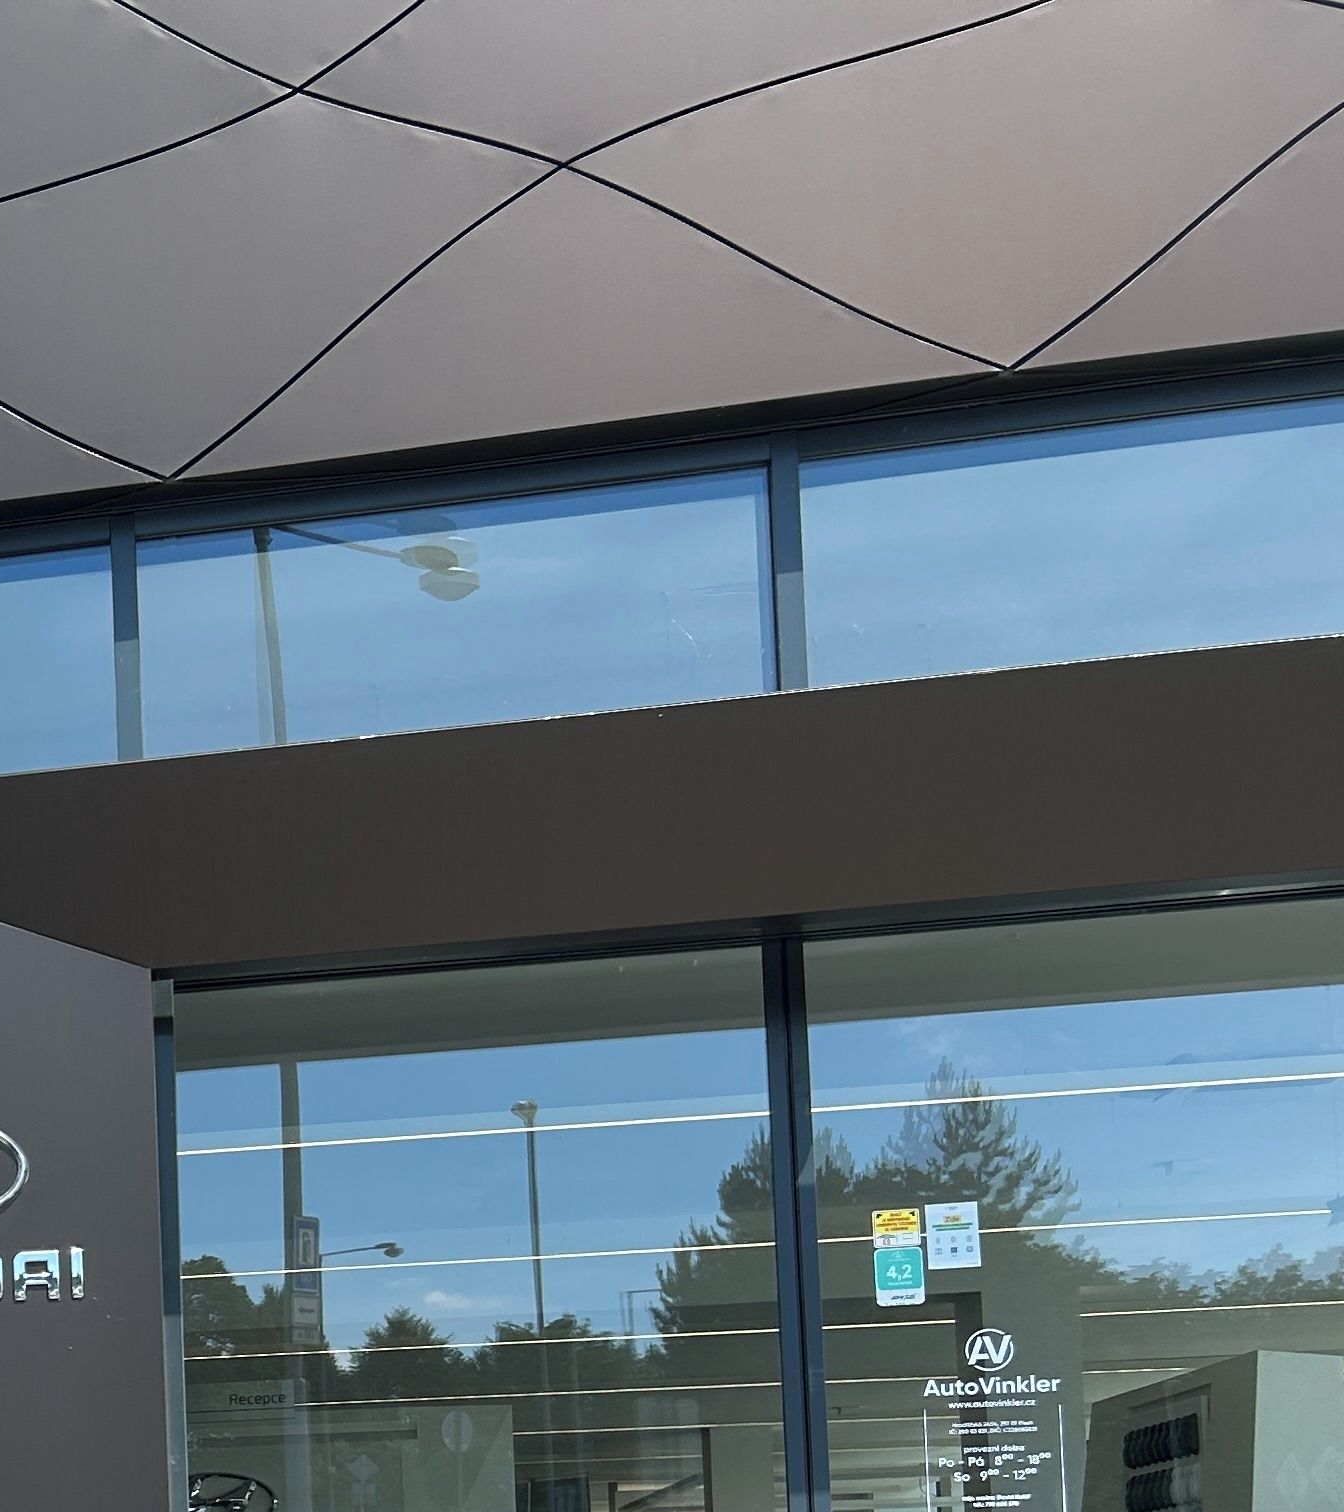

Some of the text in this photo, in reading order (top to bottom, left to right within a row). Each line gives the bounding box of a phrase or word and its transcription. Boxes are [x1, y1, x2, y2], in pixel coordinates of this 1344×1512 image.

[886, 1264, 913, 1282] 4,2
[923, 1375, 1061, 1397] AutoVinkler
[229, 1393, 286, 1406] Recepce
[938, 1457, 955, 1468] Po
[953, 1472, 971, 1482] So
